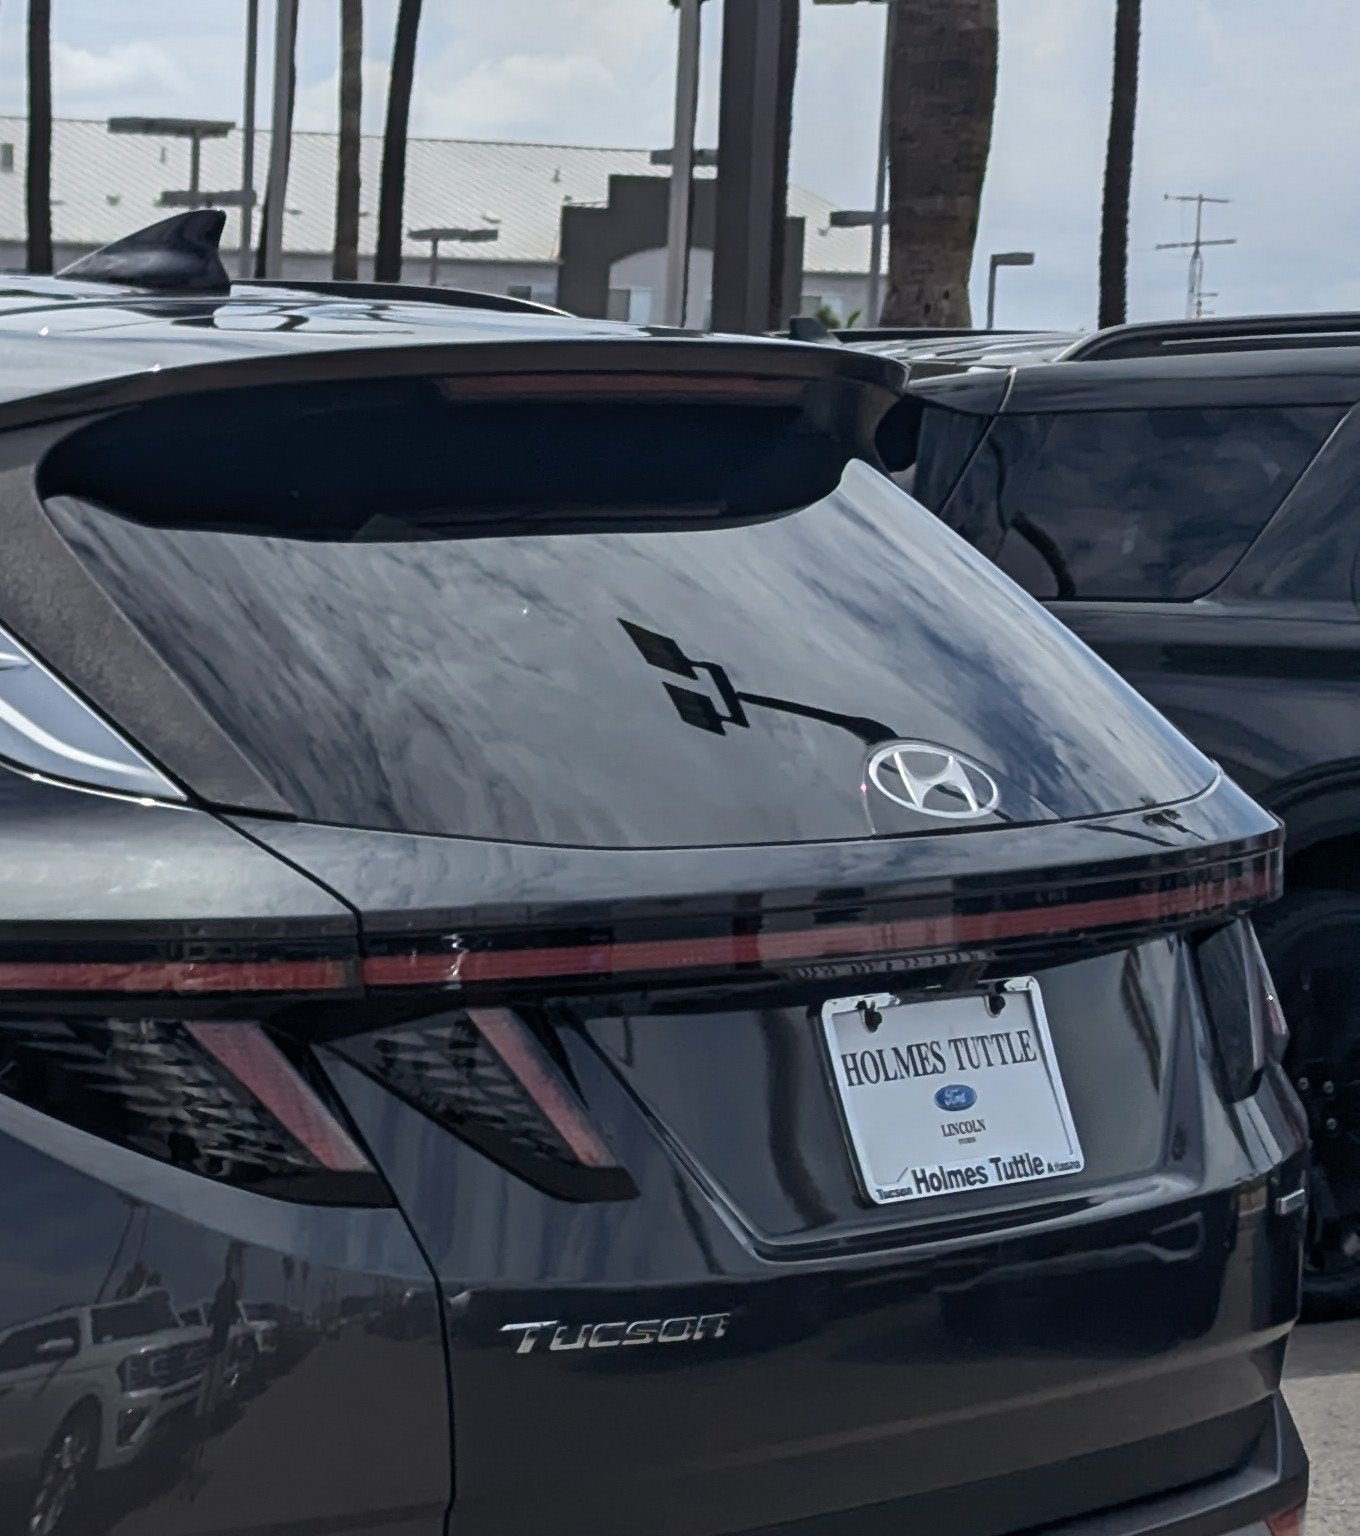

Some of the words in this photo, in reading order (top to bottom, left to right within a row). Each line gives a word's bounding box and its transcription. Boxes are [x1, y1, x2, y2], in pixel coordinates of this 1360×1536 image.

[841, 1041, 947, 1086] HOLMES
[948, 1030, 1038, 1071] TUTTLE
[941, 1119, 987, 1137] LINCOLN
[911, 1165, 989, 1195] Holmes
[988, 1152, 1046, 1182] Tuttle
